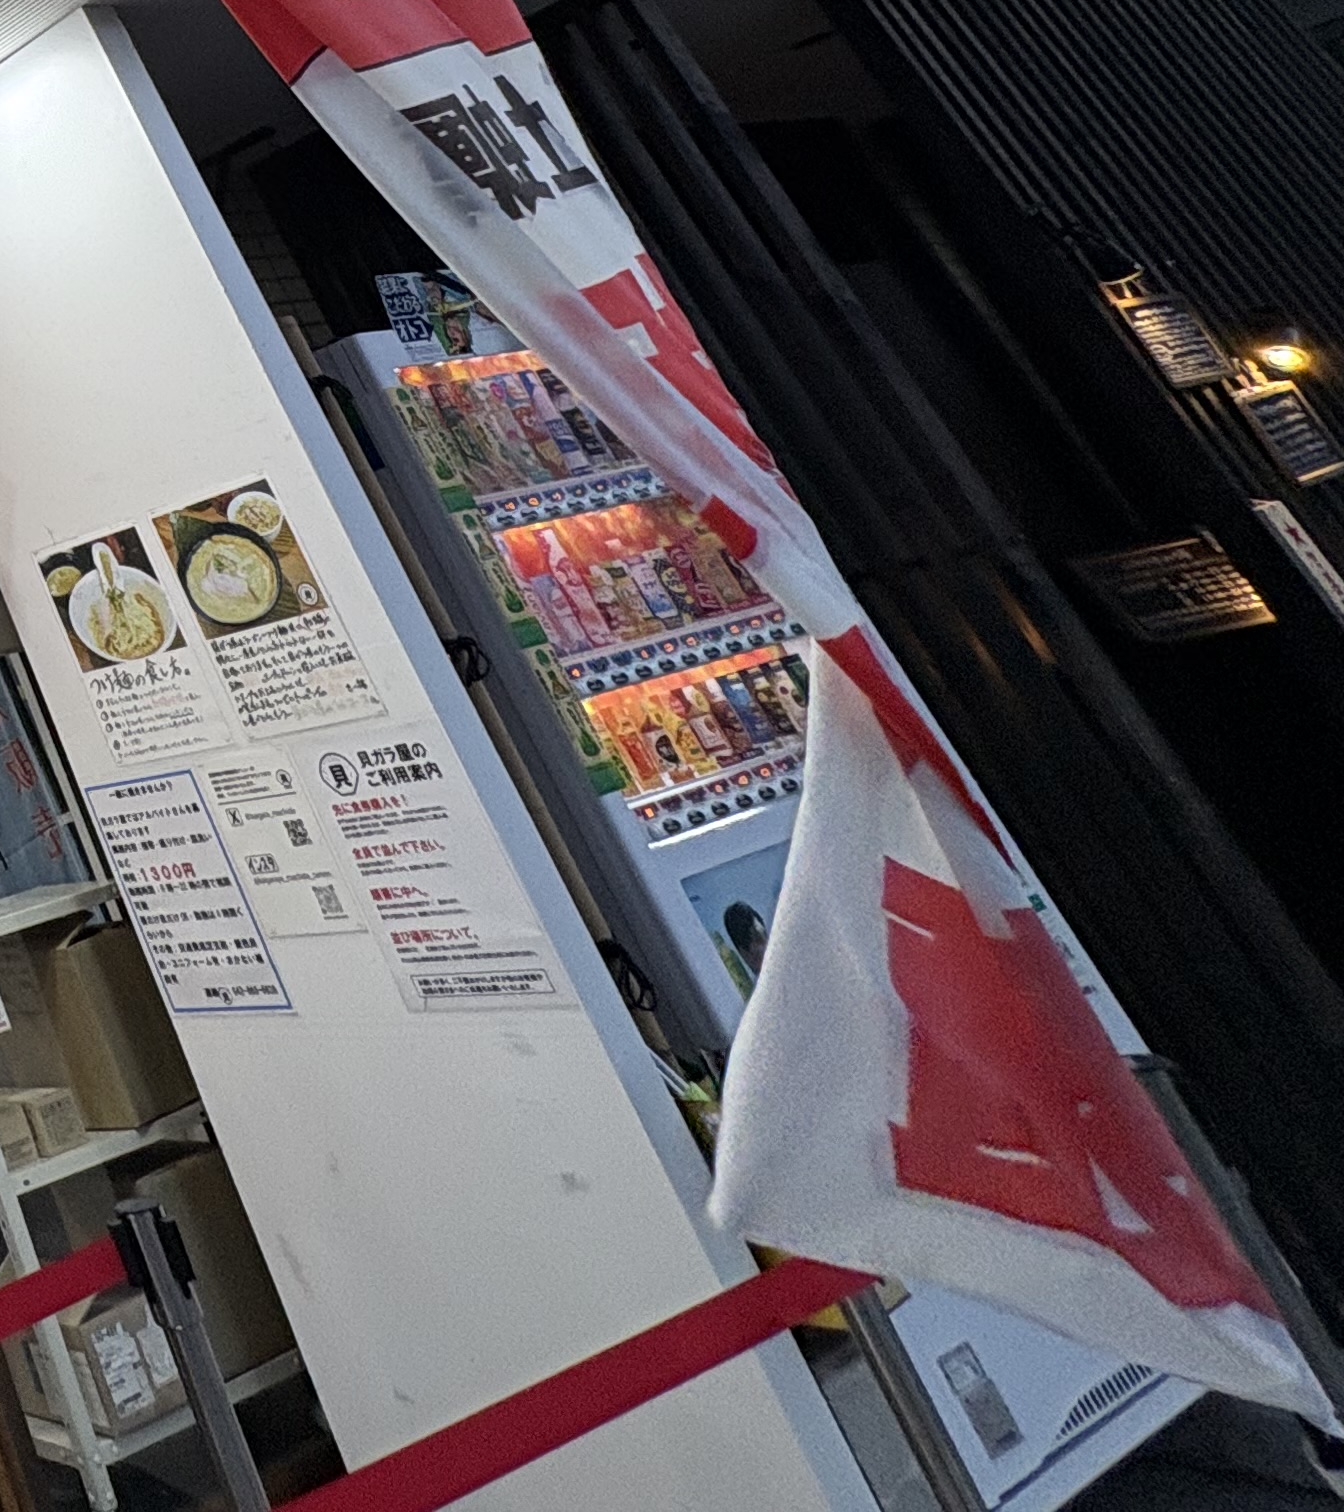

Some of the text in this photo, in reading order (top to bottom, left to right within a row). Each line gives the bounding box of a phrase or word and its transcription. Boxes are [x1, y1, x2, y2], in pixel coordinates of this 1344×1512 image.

[365, 761, 443, 787] ご利用案内
